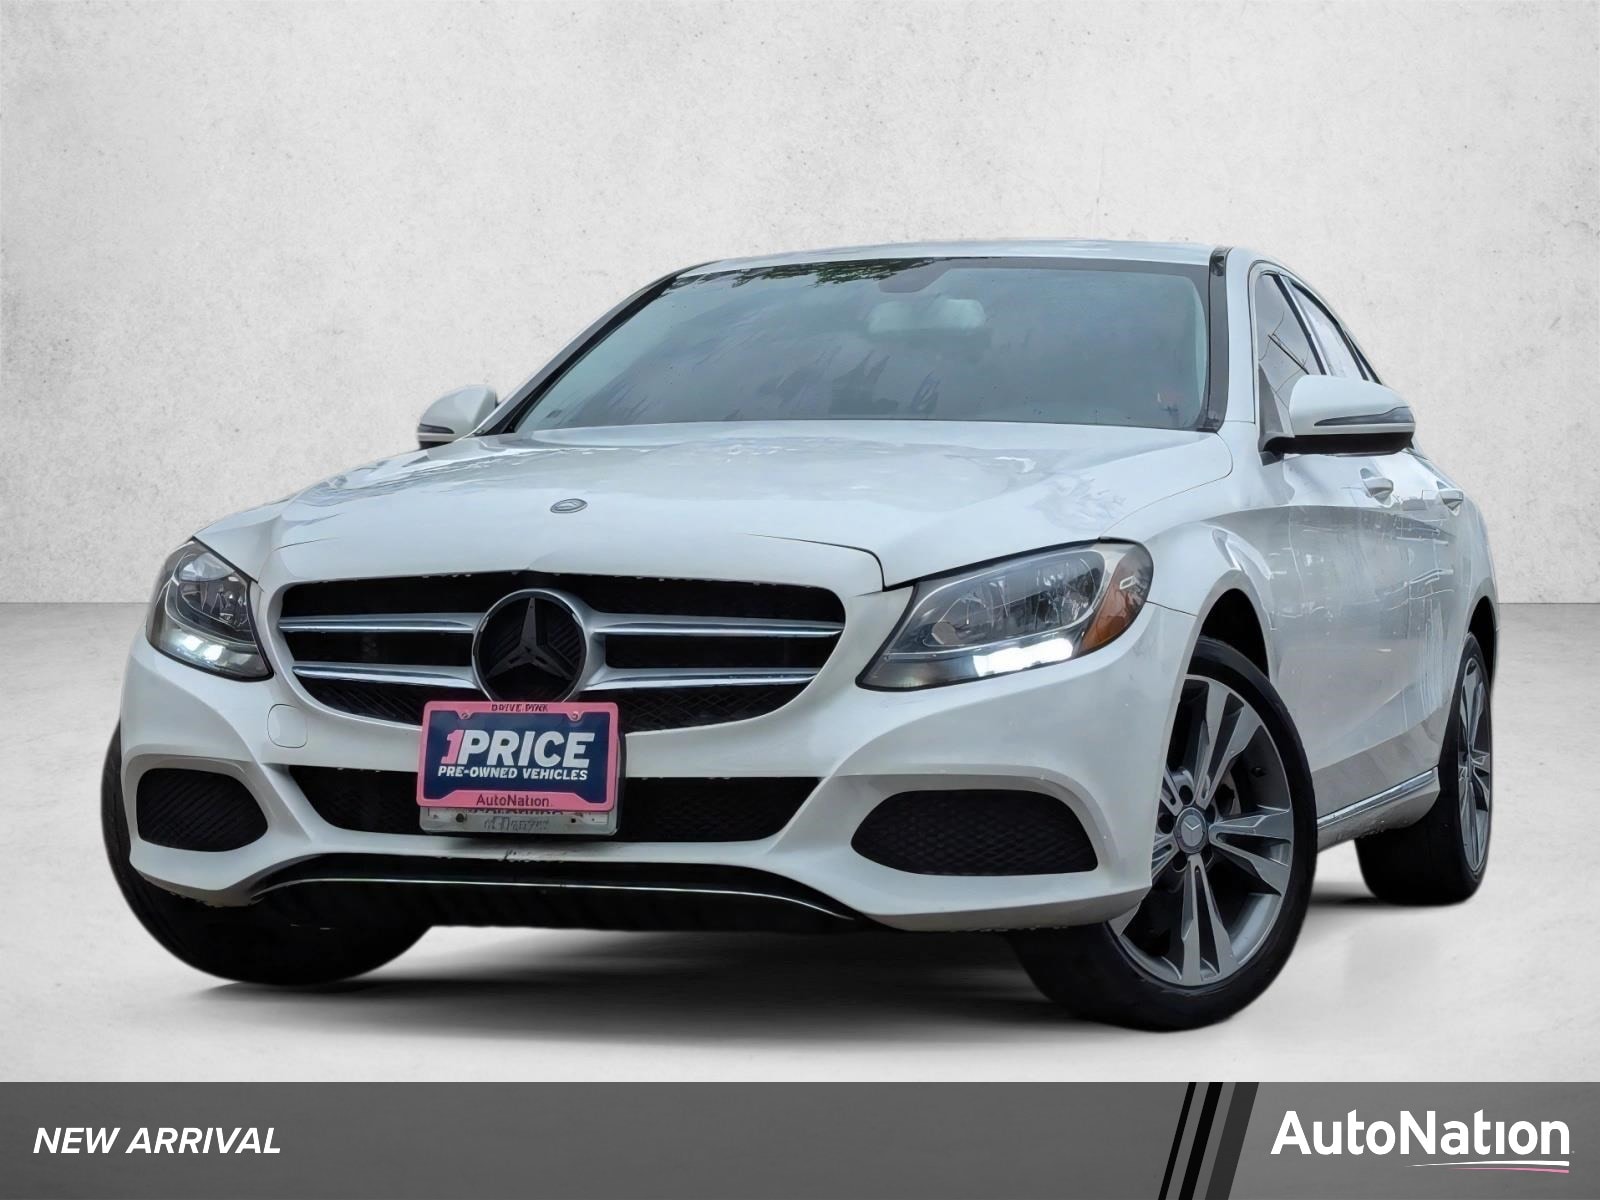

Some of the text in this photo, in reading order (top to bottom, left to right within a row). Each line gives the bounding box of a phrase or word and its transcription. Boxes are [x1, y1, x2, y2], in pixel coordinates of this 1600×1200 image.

[440, 729, 596, 769] 1PRICE
[437, 765, 589, 781] PRE-OWNED VEHICLES
[476, 794, 550, 808] AutoNation
